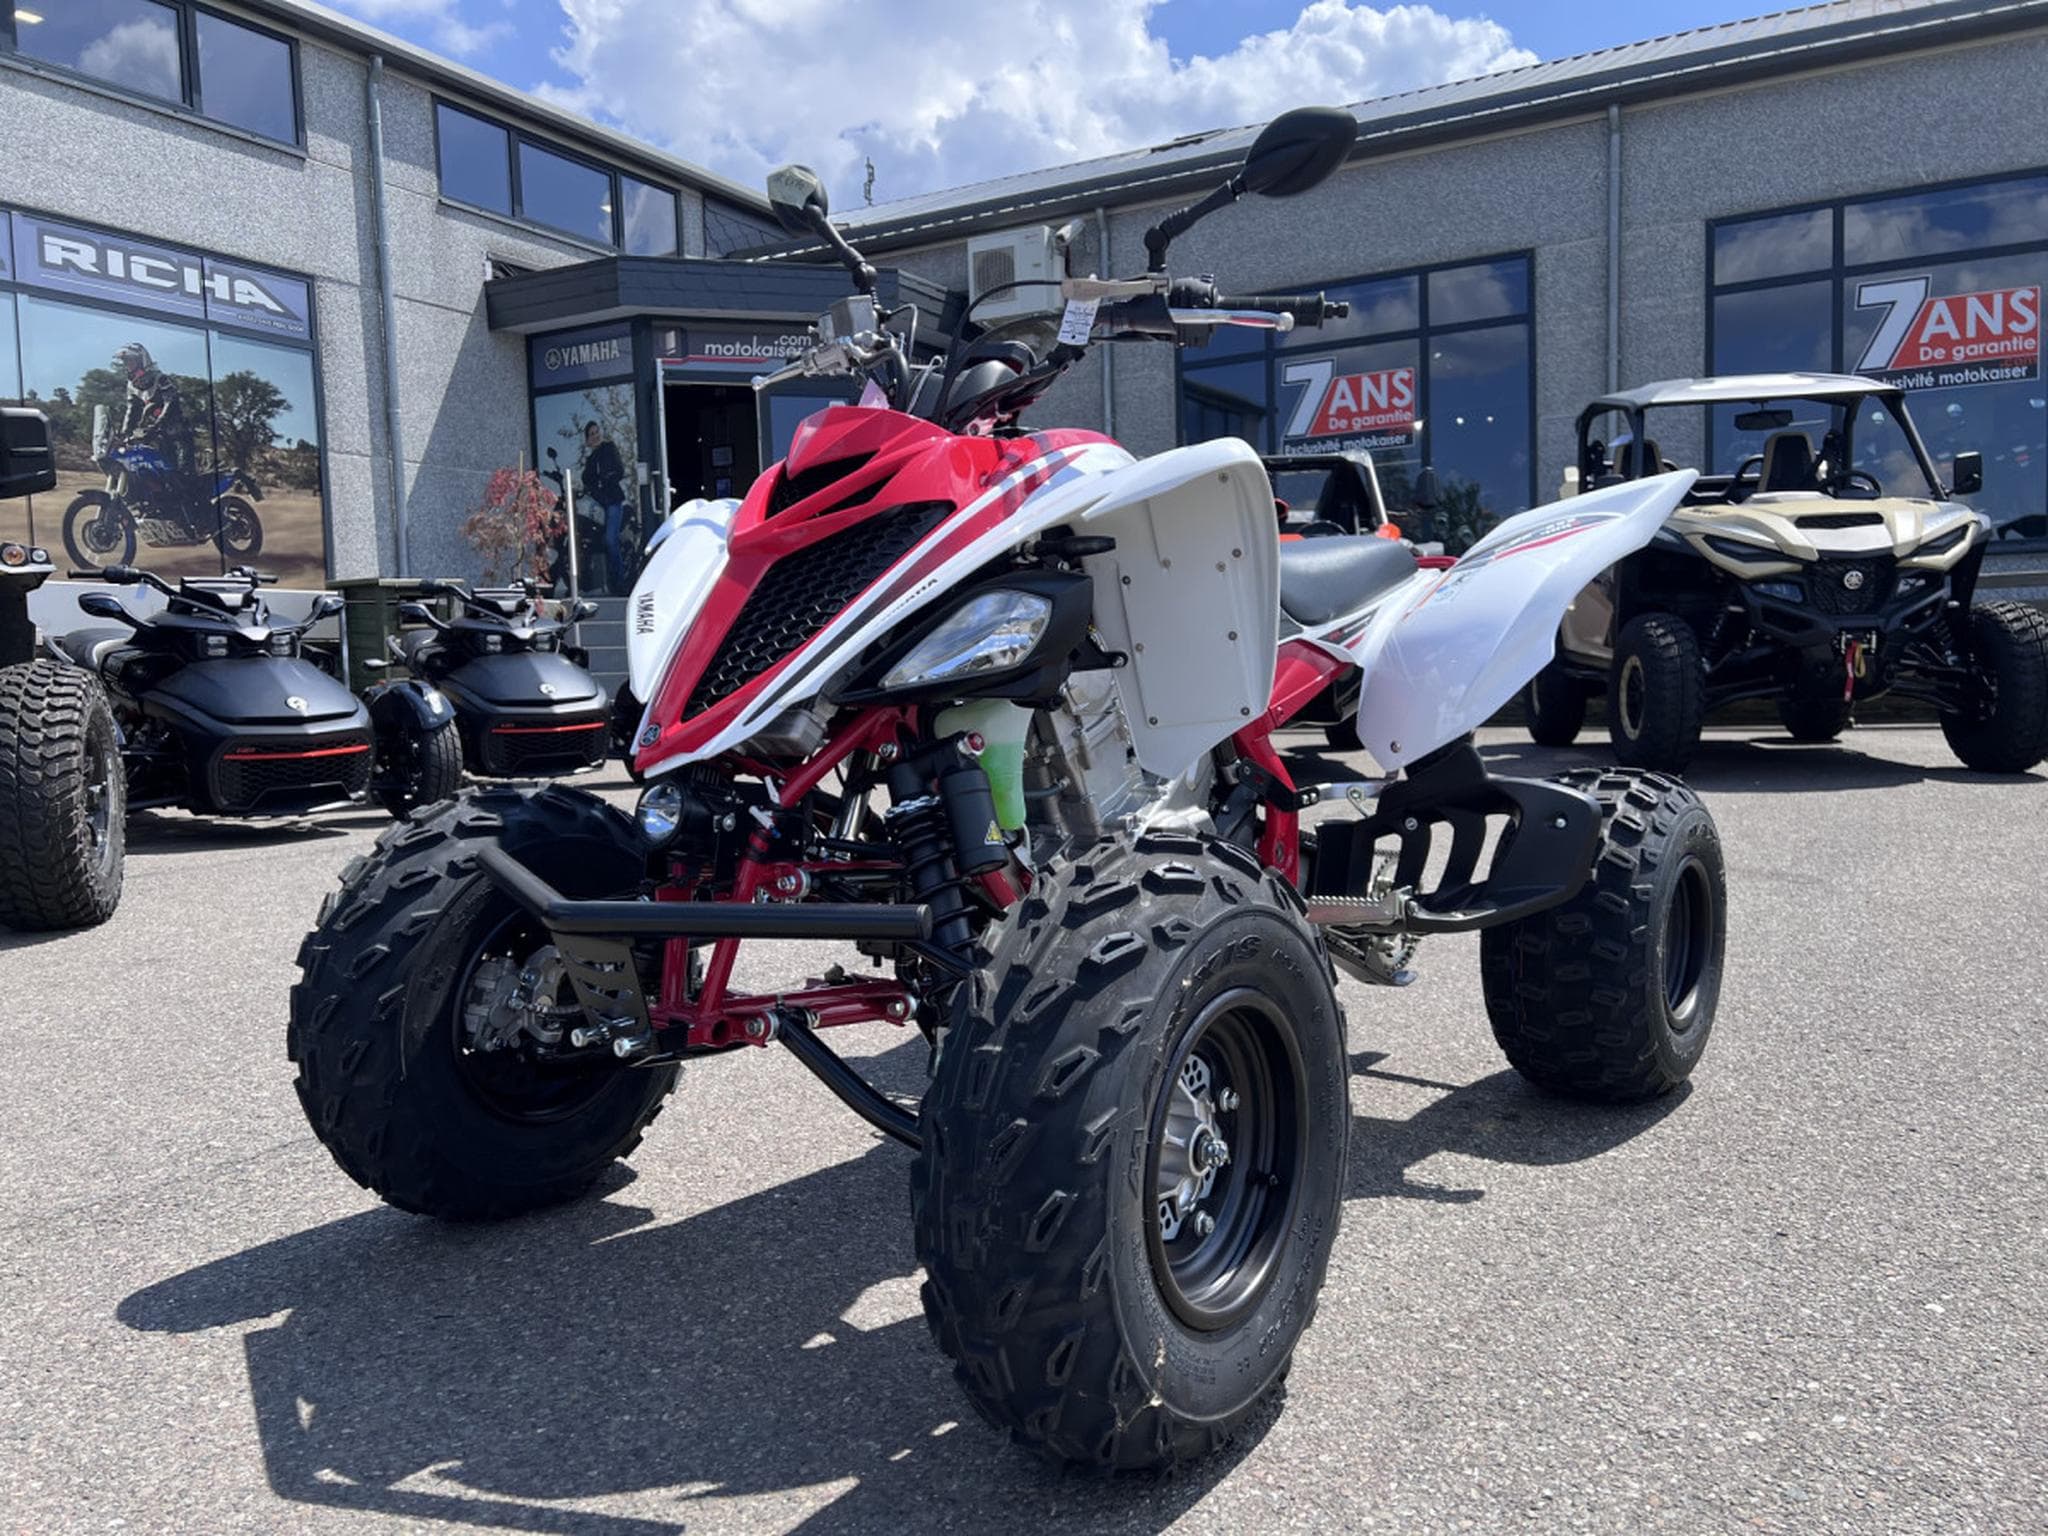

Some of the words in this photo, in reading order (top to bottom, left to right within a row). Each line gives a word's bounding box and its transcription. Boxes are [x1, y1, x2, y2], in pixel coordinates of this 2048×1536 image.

[42, 233, 286, 314] RICHA
[1858, 276, 1928, 371] 7
[1918, 289, 2038, 344] ANS
[561, 338, 620, 368] YAMAHA
[1919, 346, 1946, 362] De
[1952, 336, 2037, 361] garantie
[1285, 361, 1333, 436] 7
[1327, 371, 1413, 415] ANS
[1328, 416, 1349, 430] De
[1351, 409, 1413, 430] garantie
[636, 590, 655, 636] YAMAHA
